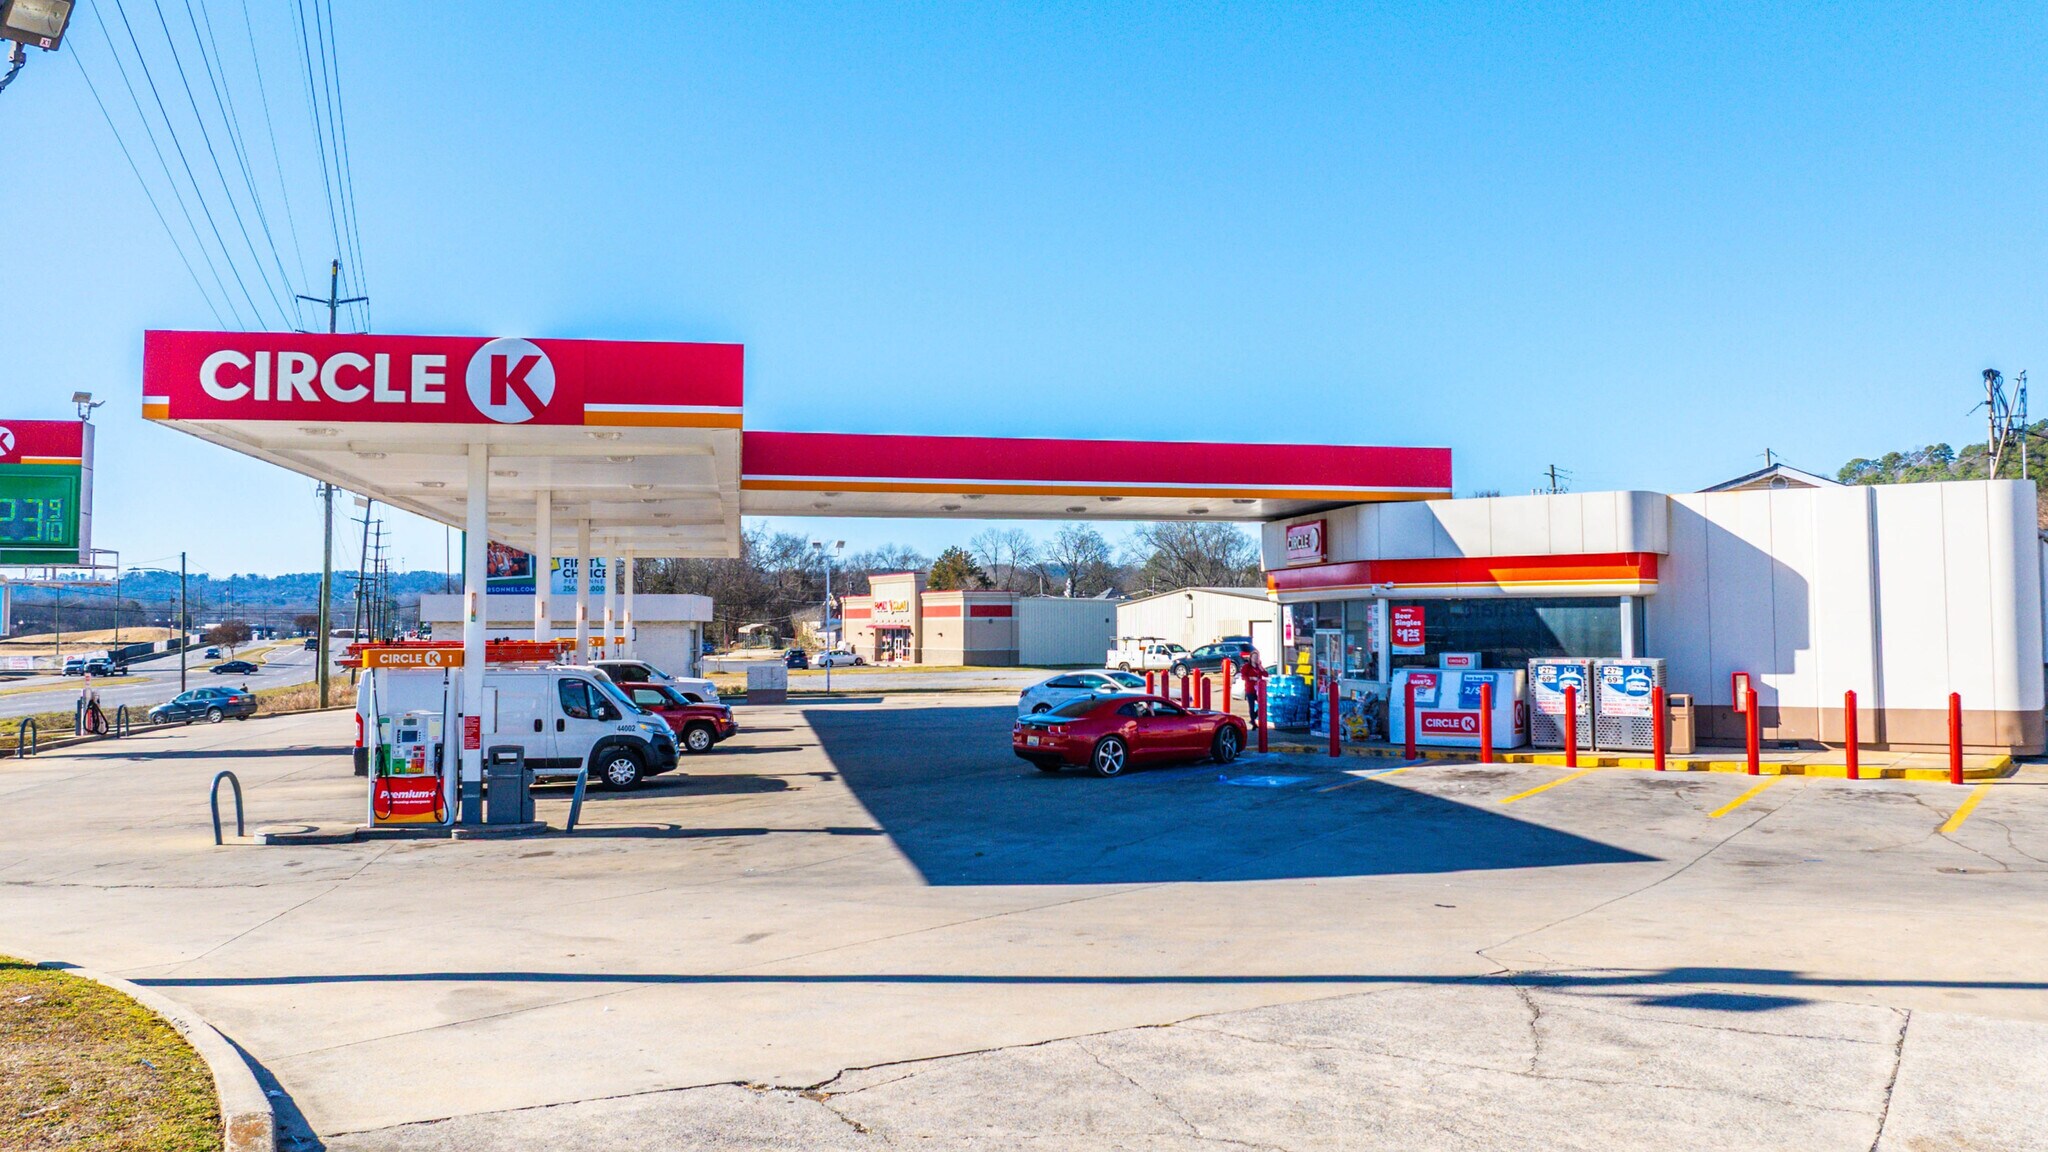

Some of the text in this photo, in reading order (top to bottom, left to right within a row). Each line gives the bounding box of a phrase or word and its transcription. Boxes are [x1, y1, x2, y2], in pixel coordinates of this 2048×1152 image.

[200, 350, 548, 418] CIRCLE K
[563, 558, 595, 568] FIT
[562, 568, 606, 578] CHICE
[1394, 619, 1421, 627] Singles
[380, 653, 422, 664] CIRCLE
[448, 655, 453, 663] 1
[1425, 718, 1474, 731] CIRCLE K
